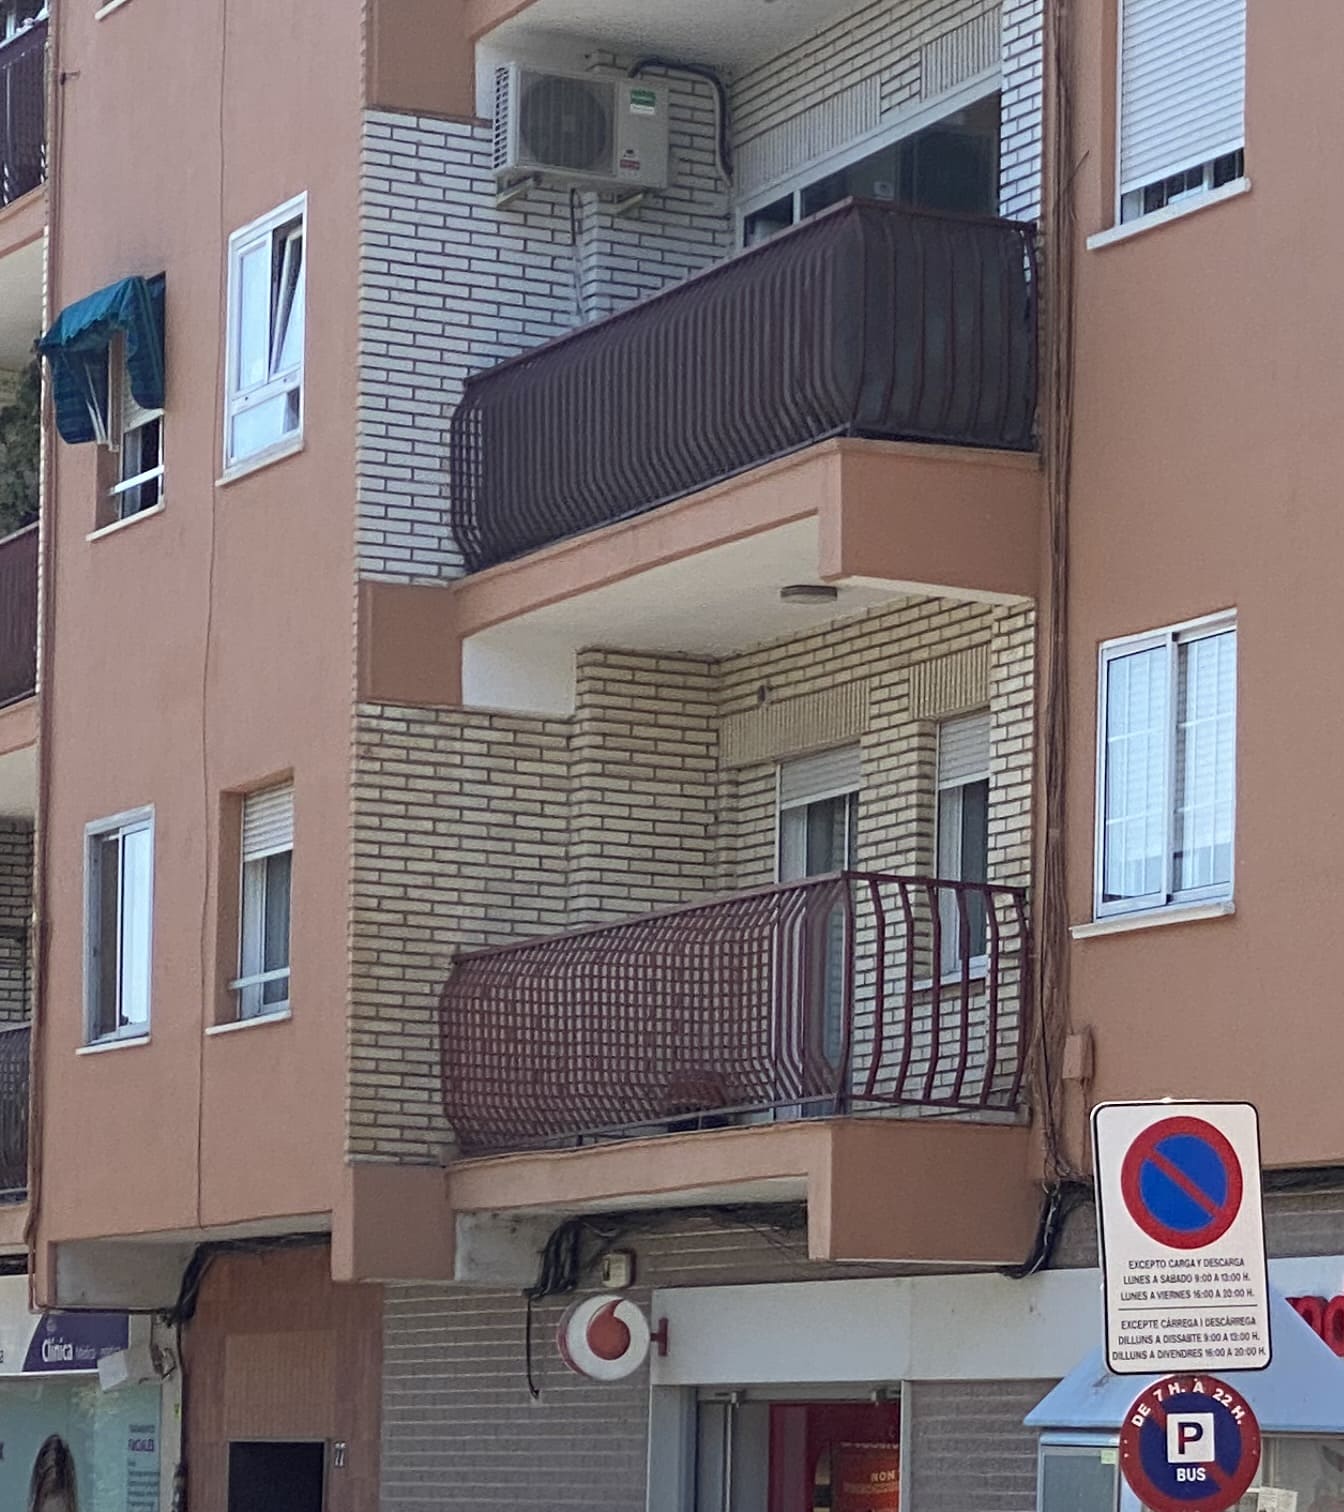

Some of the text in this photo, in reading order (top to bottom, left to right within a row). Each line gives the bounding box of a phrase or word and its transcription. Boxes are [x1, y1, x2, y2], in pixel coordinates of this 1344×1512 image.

[1128, 1258, 1245, 1270] EXCEPTO CARGA Y DESCARGA
[1123, 1275, 1151, 1285] LUNES
[1152, 1274, 1159, 1284] A
[1194, 1273, 1213, 1283] 9:00
[1213, 1272, 1220, 1282] A
[1242, 1272, 1251, 1281] H.
[1120, 1291, 1148, 1301] LUNES
[1149, 1290, 1156, 1300] A
[1157, 1289, 1191, 1300] VIERNES
[1215, 1288, 1221, 1298] A
[1222, 1288, 1245, 1298] 20:00
[1246, 1288, 1255, 1297] H.
[1121, 1320, 1159, 1330] EXCEPTE
[1118, 1334, 1153, 1345] DILLUNS
[1154, 1334, 1161, 1344] A
[1163, 1334, 1201, 1344] DISSABTE
[1203, 1333, 1221, 1343] 9:00
[1222, 1332, 1229, 1342] A
[1251, 1331, 1260, 1341] H.
[1112, 1350, 1147, 1361] DILLUNS
[1149, 1349, 1155, 1359] A
[1157, 1348, 1203, 1359] DIVENDRES
[1226, 1347, 1233, 1357] A
[1234, 1346, 1256, 1357] 20:00
[1258, 1346, 1266, 1356] H.
[1131, 1403, 1152, 1428] DE
[1152, 1388, 1164, 1402] 7
[1168, 1382, 1186, 1396] H.
[1212, 1388, 1233, 1408] 22
[1177, 1422, 1204, 1455] P
[1176, 1468, 1207, 1481] BUS
